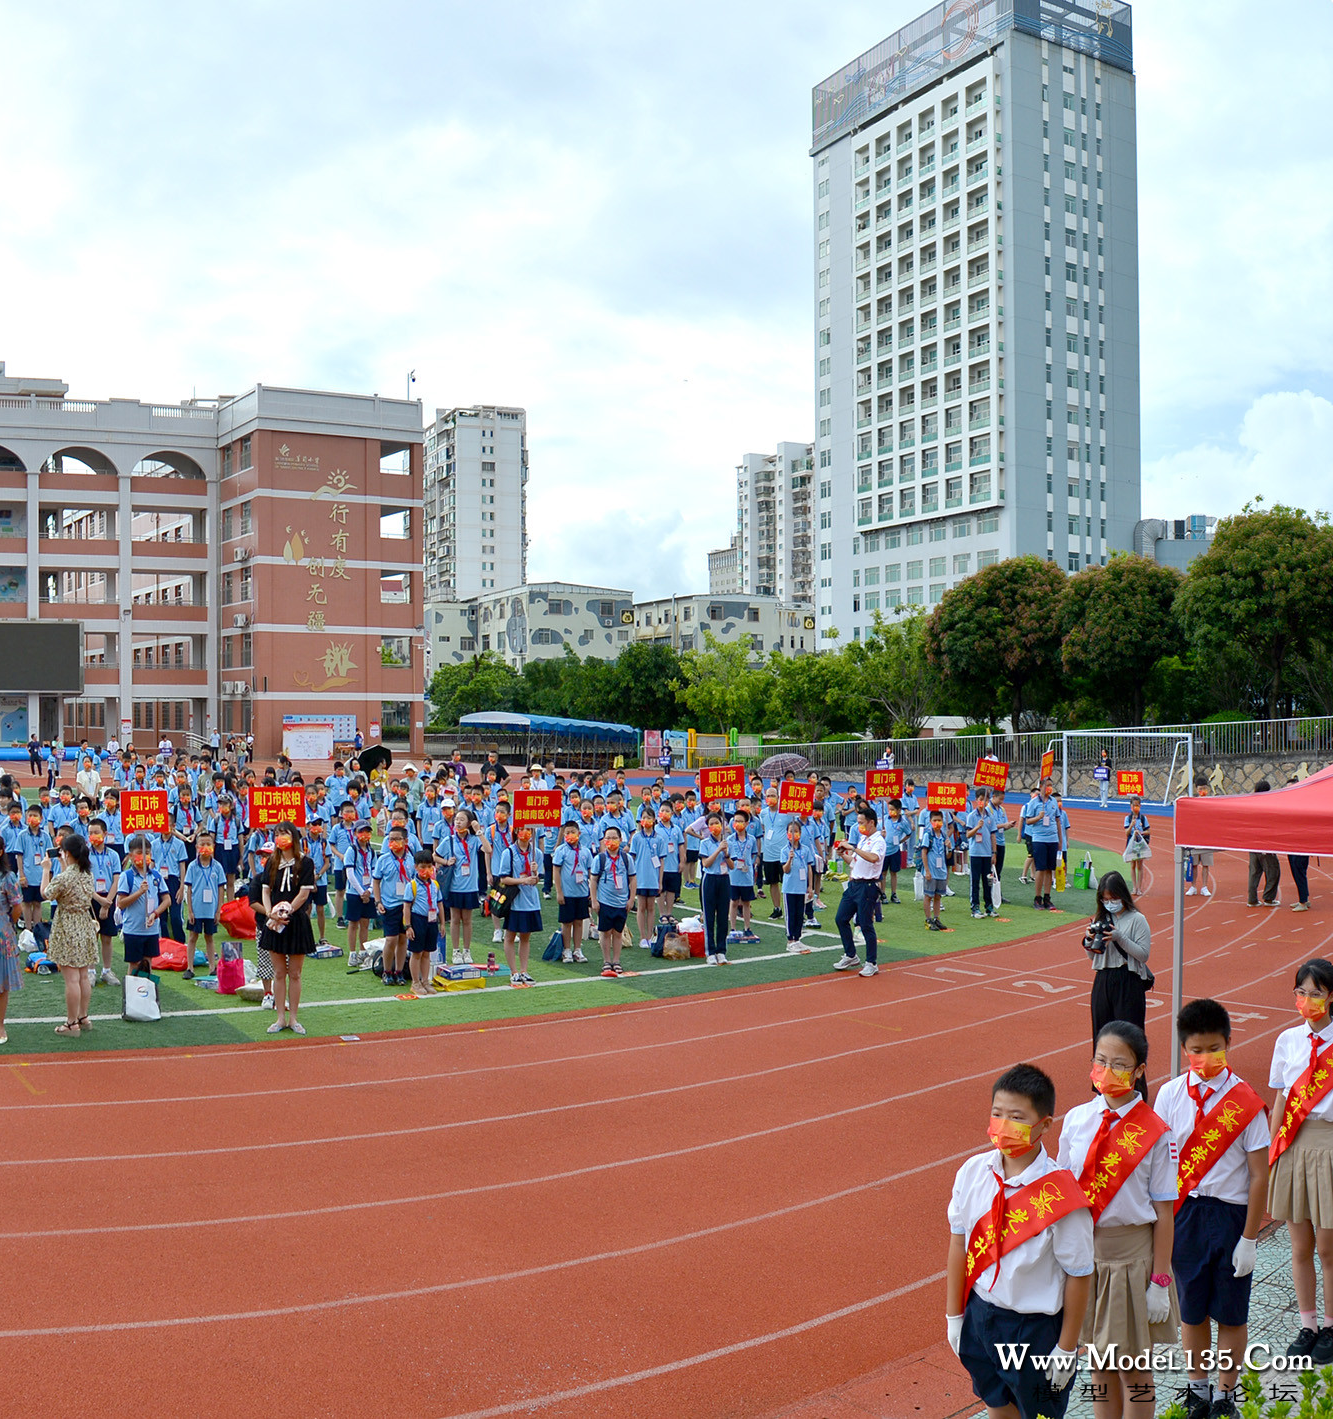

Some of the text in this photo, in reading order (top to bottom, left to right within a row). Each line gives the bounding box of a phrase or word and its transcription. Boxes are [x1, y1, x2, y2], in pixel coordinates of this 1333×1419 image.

[329, 503, 351, 580] 行有度
[305, 556, 328, 631] 创无疆
[709, 770, 736, 783] 厦门市
[873, 772, 896, 784] 厦门市
[1121, 774, 1139, 782] 厦门市
[705, 784, 741, 798] 思北小学
[788, 785, 807, 798] 厦门市
[869, 784, 900, 796] 文安小学
[937, 786, 957, 794] 厦门市
[130, 795, 159, 811] 厦门市
[253, 791, 301, 806] 厦门市松柏
[527, 795, 549, 806] 厦门市
[125, 813, 165, 828] 大同小学
[259, 808, 297, 823] 第二小学
[1012, 980, 1077, 994] 2
